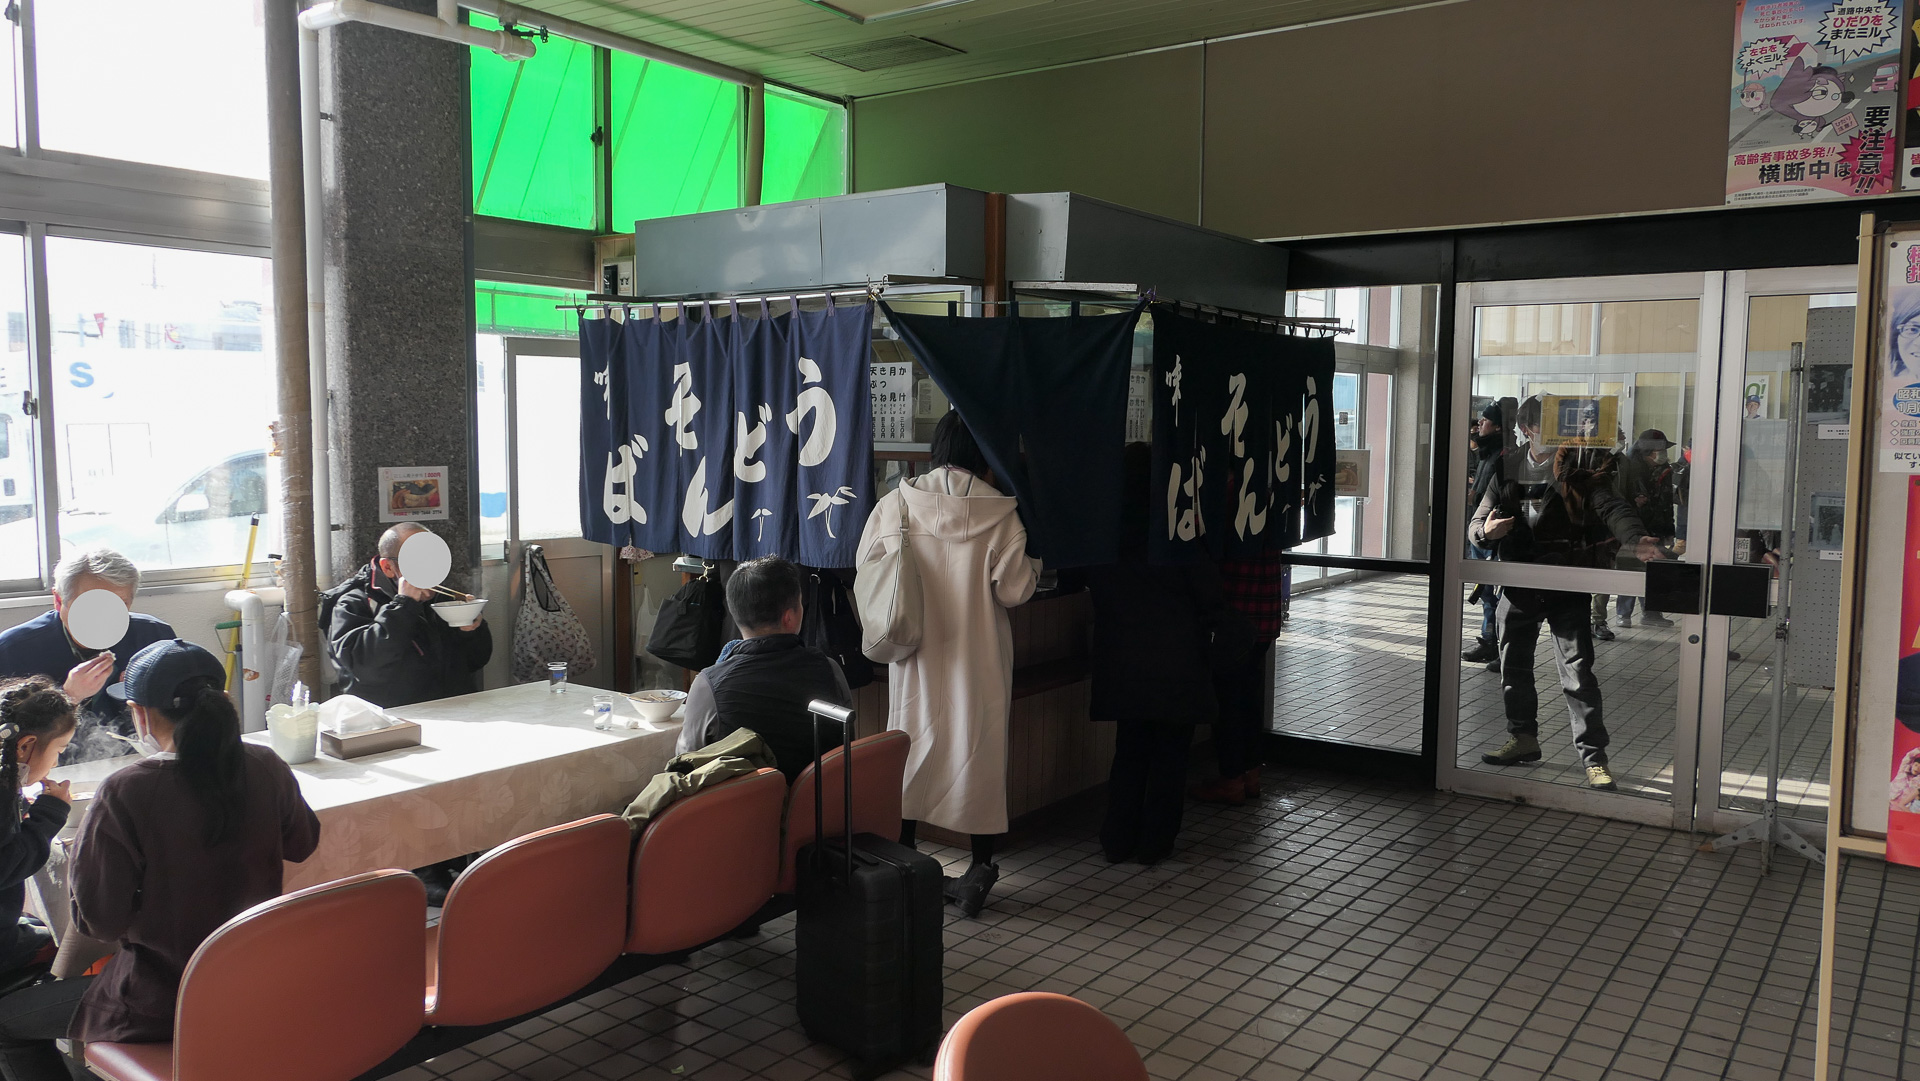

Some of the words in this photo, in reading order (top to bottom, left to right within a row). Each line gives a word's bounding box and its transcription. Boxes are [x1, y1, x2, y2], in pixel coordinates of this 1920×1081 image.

[1838, 6, 1881, 15] 道路中央で
[1833, 15, 1883, 28] ひだりを
[1830, 27, 1882, 40] またミル
[1750, 44, 1777, 56] 左右を
[1746, 53, 1781, 66] よくミル
[1758, 159, 1852, 184] 横断中は
[889, 366, 897, 402] 月見
